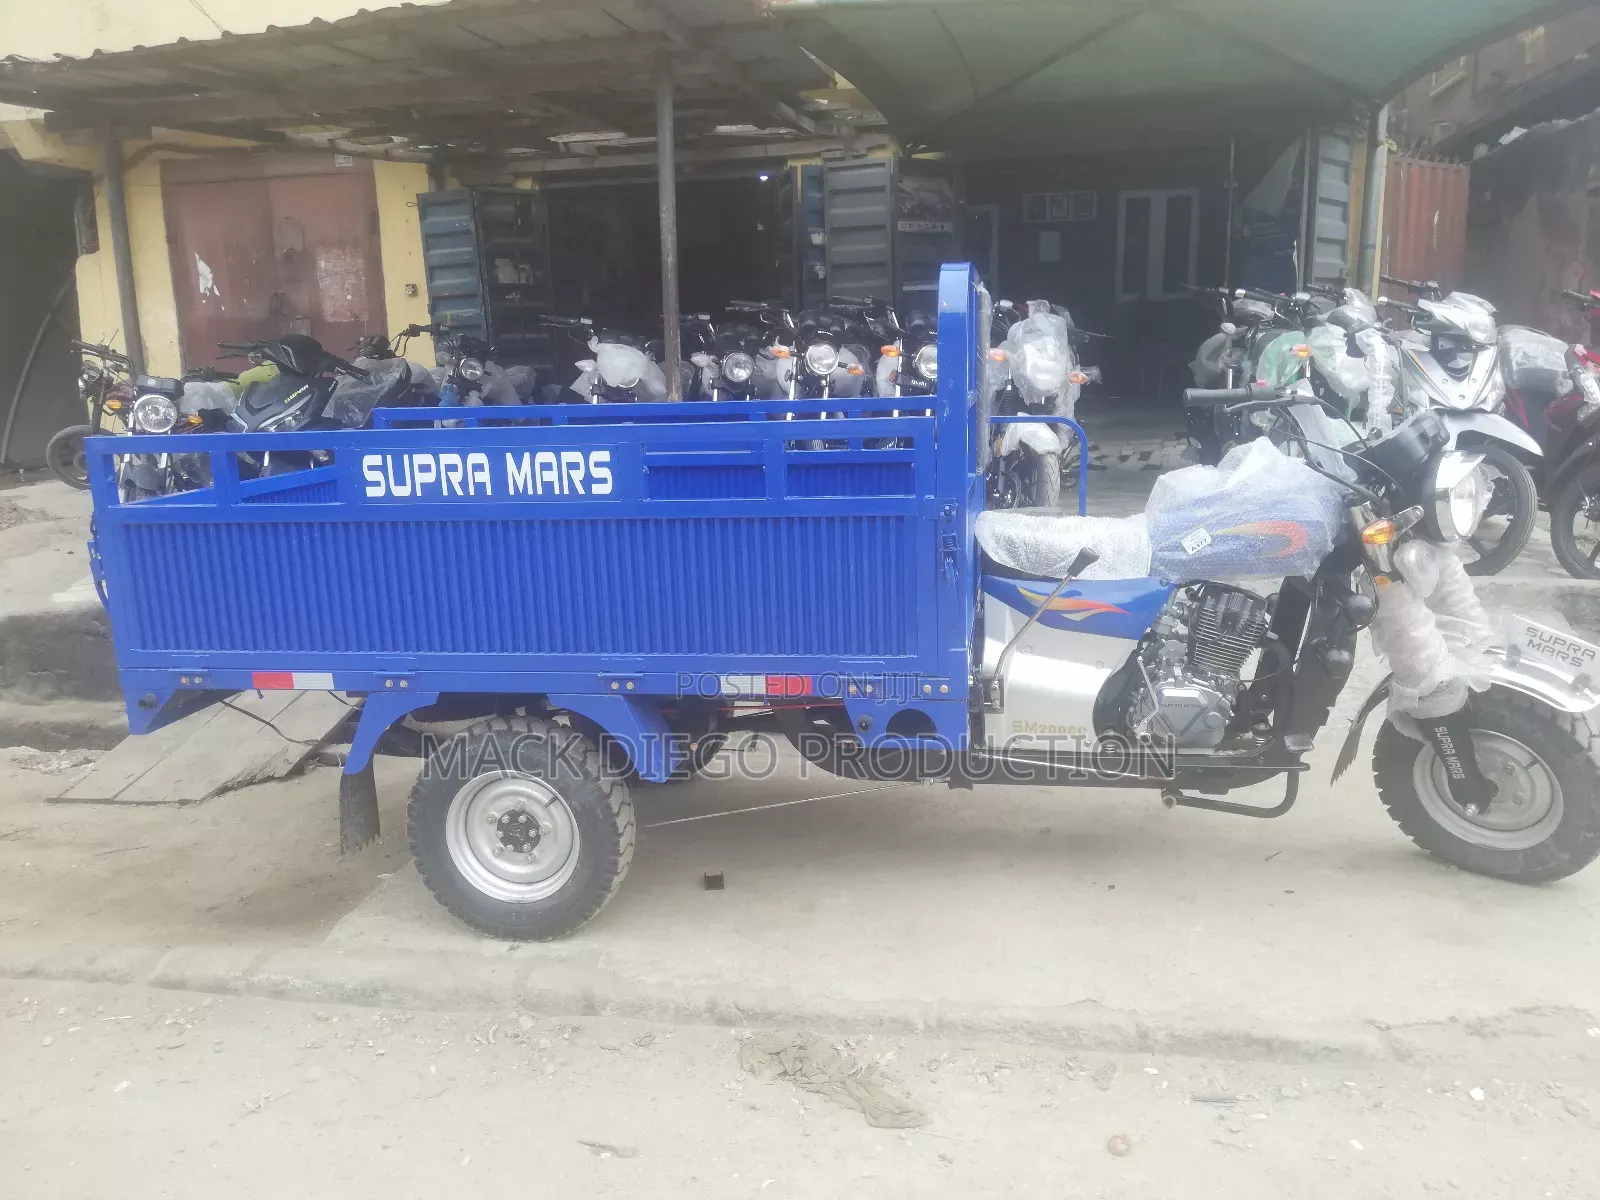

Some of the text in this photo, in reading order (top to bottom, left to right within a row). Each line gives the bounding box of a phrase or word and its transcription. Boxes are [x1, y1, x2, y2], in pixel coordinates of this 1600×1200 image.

[362, 450, 613, 497] SUPRA MARS
[1525, 626, 1596, 661] SUPRA
[1526, 638, 1584, 667] MARS
[1434, 726, 1466, 779] SUPRA MARS
